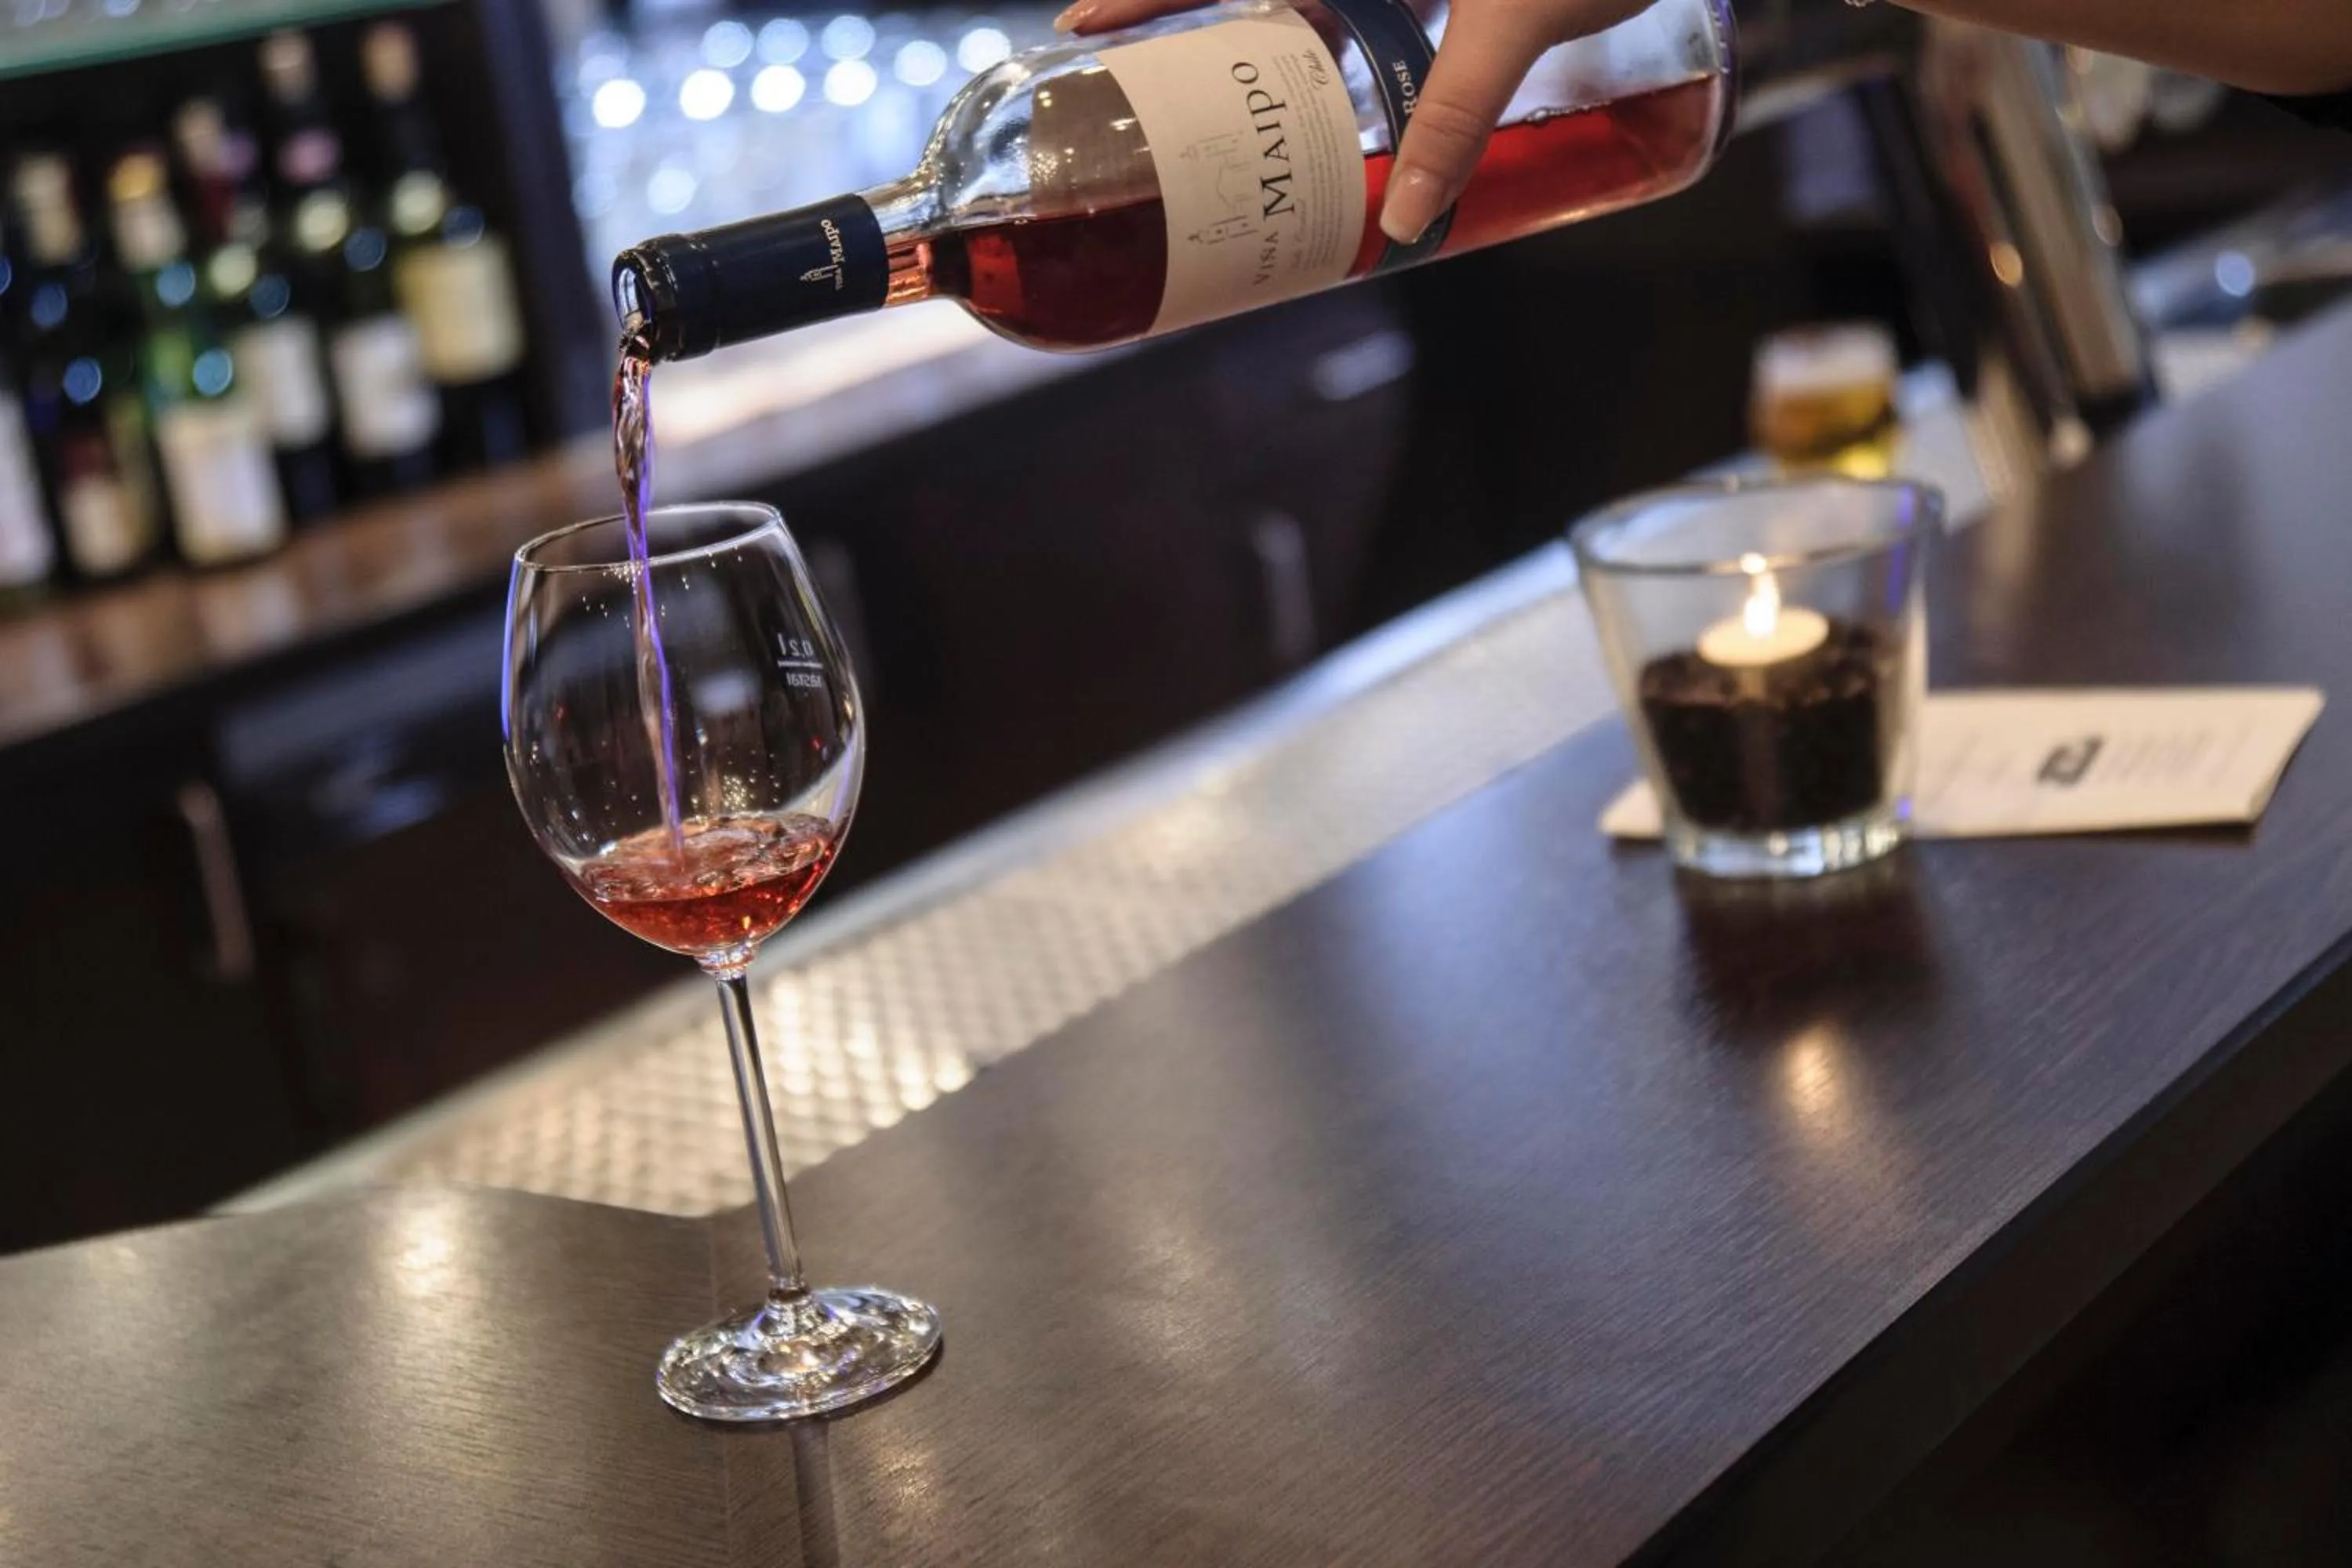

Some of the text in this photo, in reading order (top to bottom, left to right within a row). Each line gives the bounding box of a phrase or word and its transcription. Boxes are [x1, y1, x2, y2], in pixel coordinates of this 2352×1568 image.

[1301, 48, 1329, 90] Chile
[1232, 61, 1294, 222] MAIPO
[820, 219, 846, 264] MAIPO
